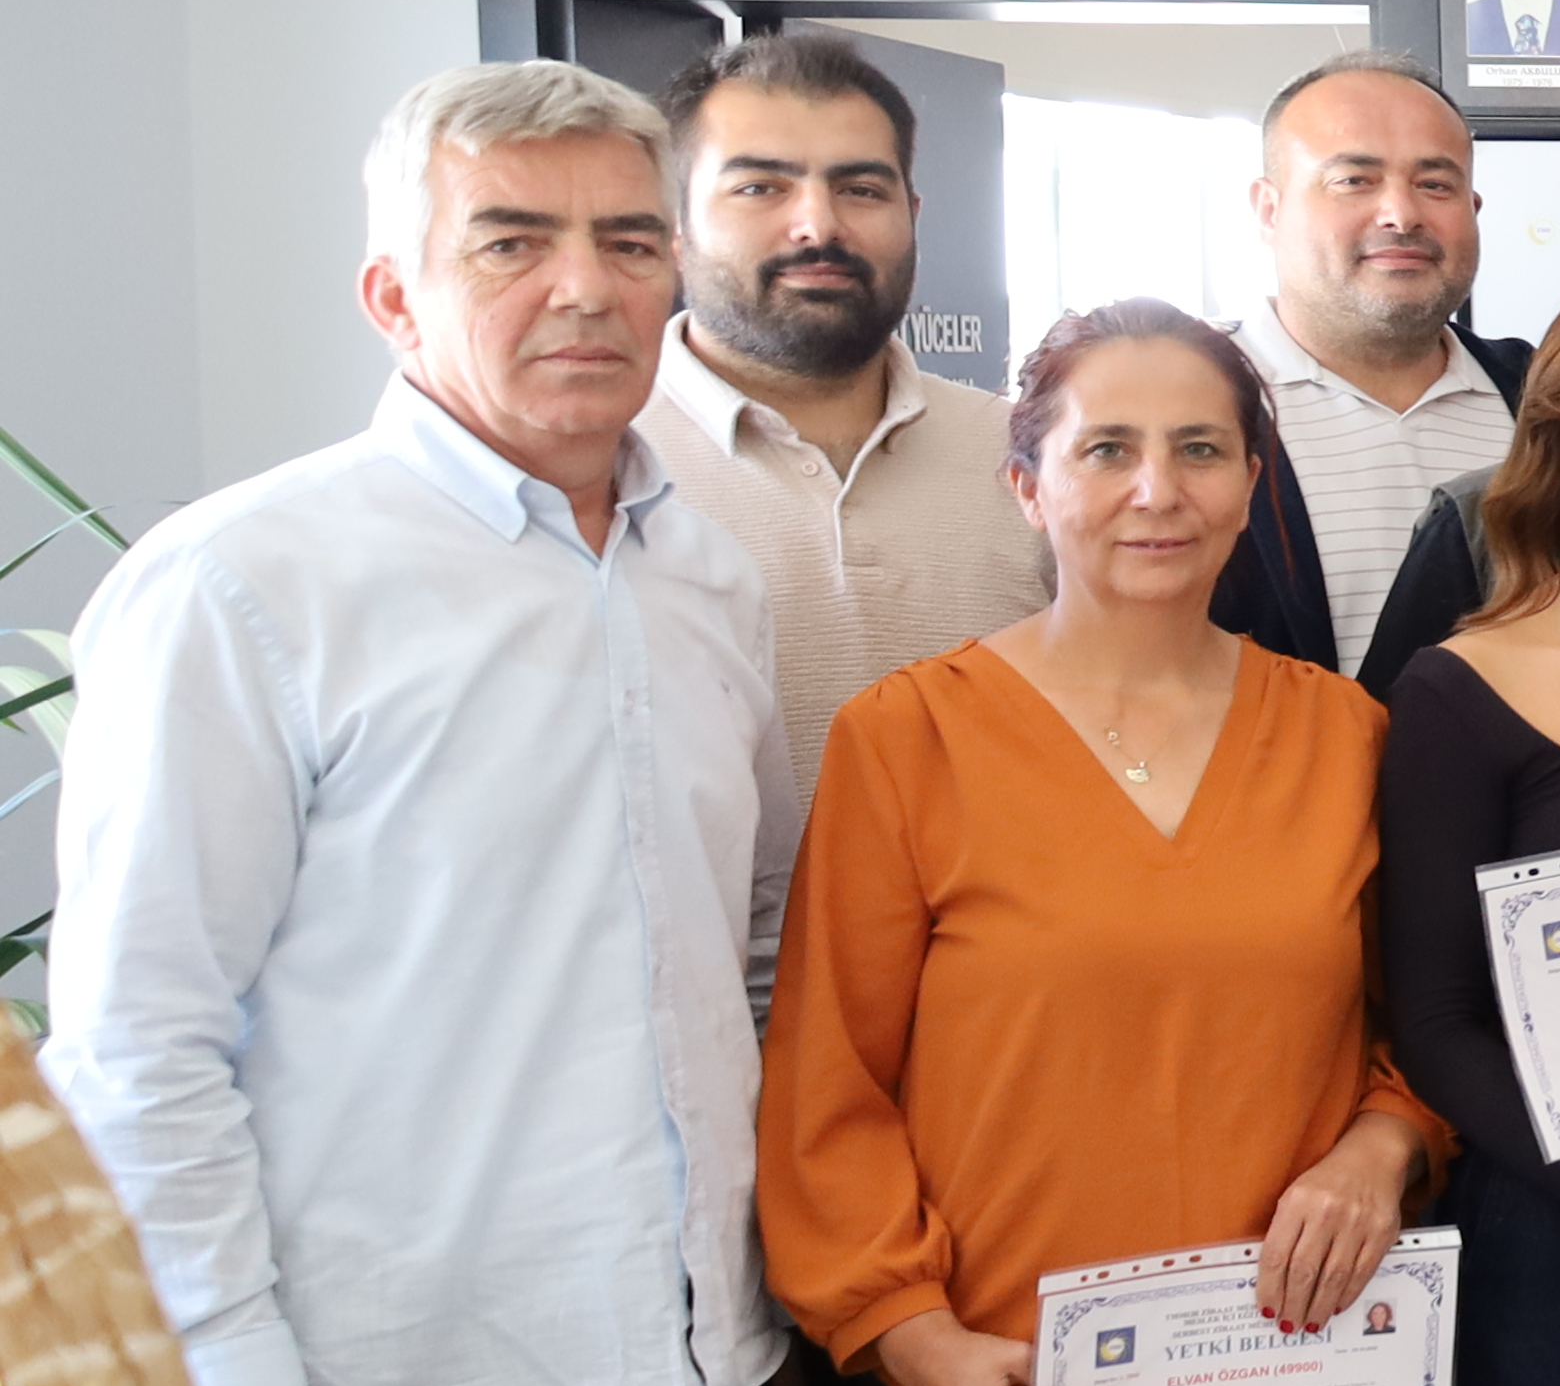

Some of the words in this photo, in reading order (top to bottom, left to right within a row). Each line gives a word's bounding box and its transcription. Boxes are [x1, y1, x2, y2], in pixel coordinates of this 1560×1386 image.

[1486, 67, 1517, 75] Orhan
[911, 305, 983, 353] YÜCELER
[1164, 1335, 1231, 1362] YETKİ
[1239, 1324, 1334, 1355] BELGESİ
[1217, 1363, 1270, 1383] ÖZGAN
[1274, 1359, 1324, 1378] (49900)
